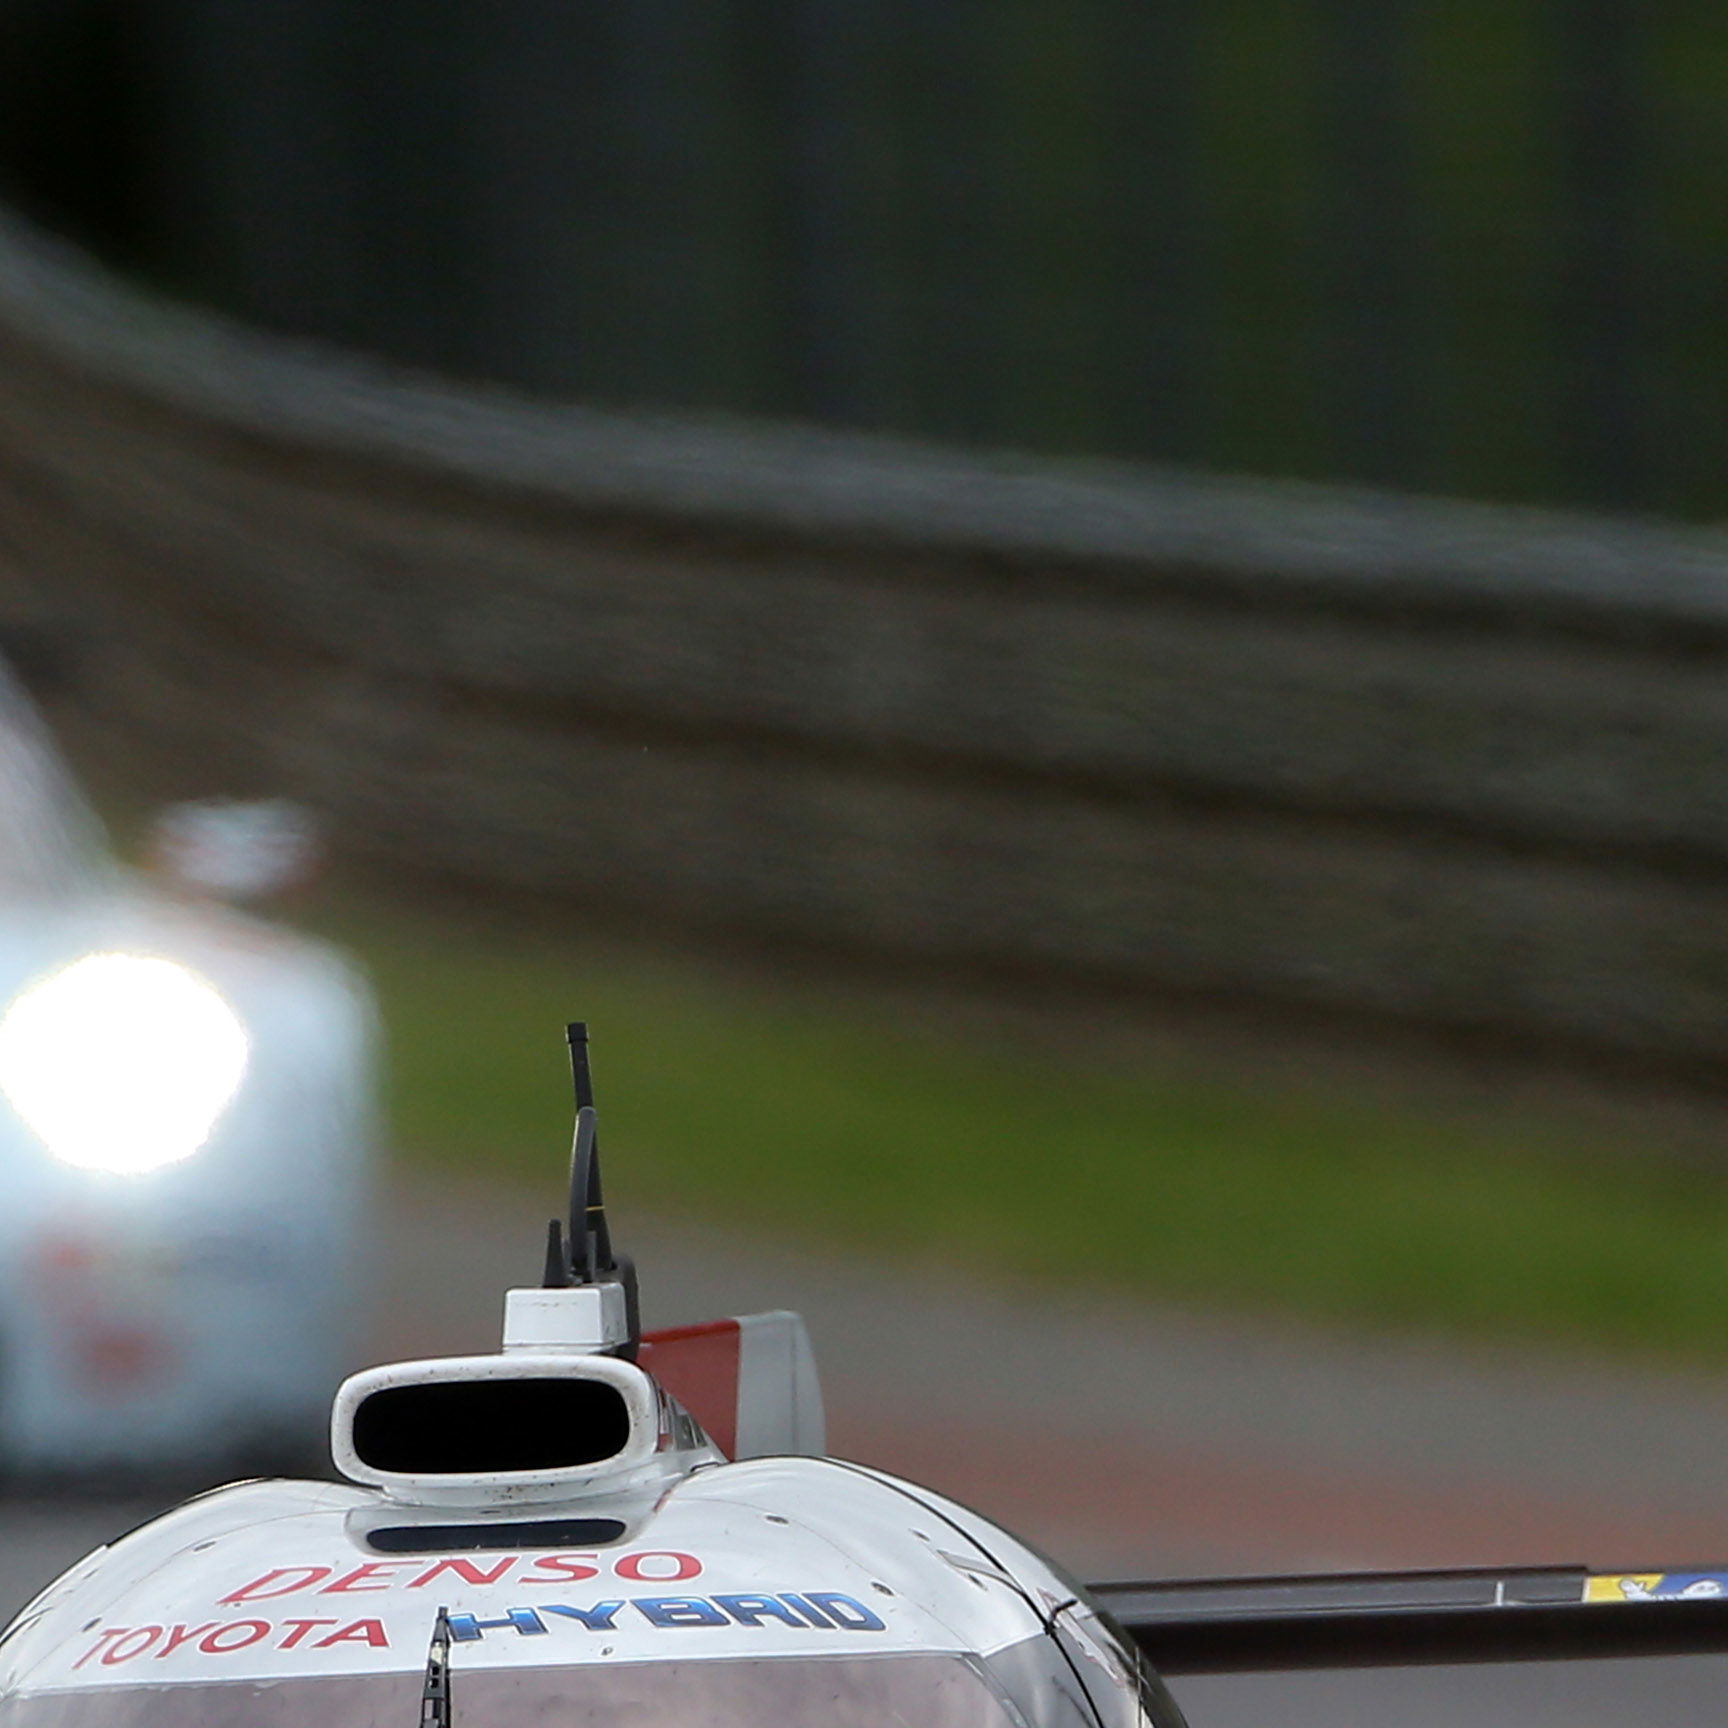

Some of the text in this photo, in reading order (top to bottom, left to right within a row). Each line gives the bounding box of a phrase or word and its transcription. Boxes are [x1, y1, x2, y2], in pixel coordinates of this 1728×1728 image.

[219, 1550, 704, 1603] DENSO
[71, 1590, 889, 1671] TOYOTA HYBRID
